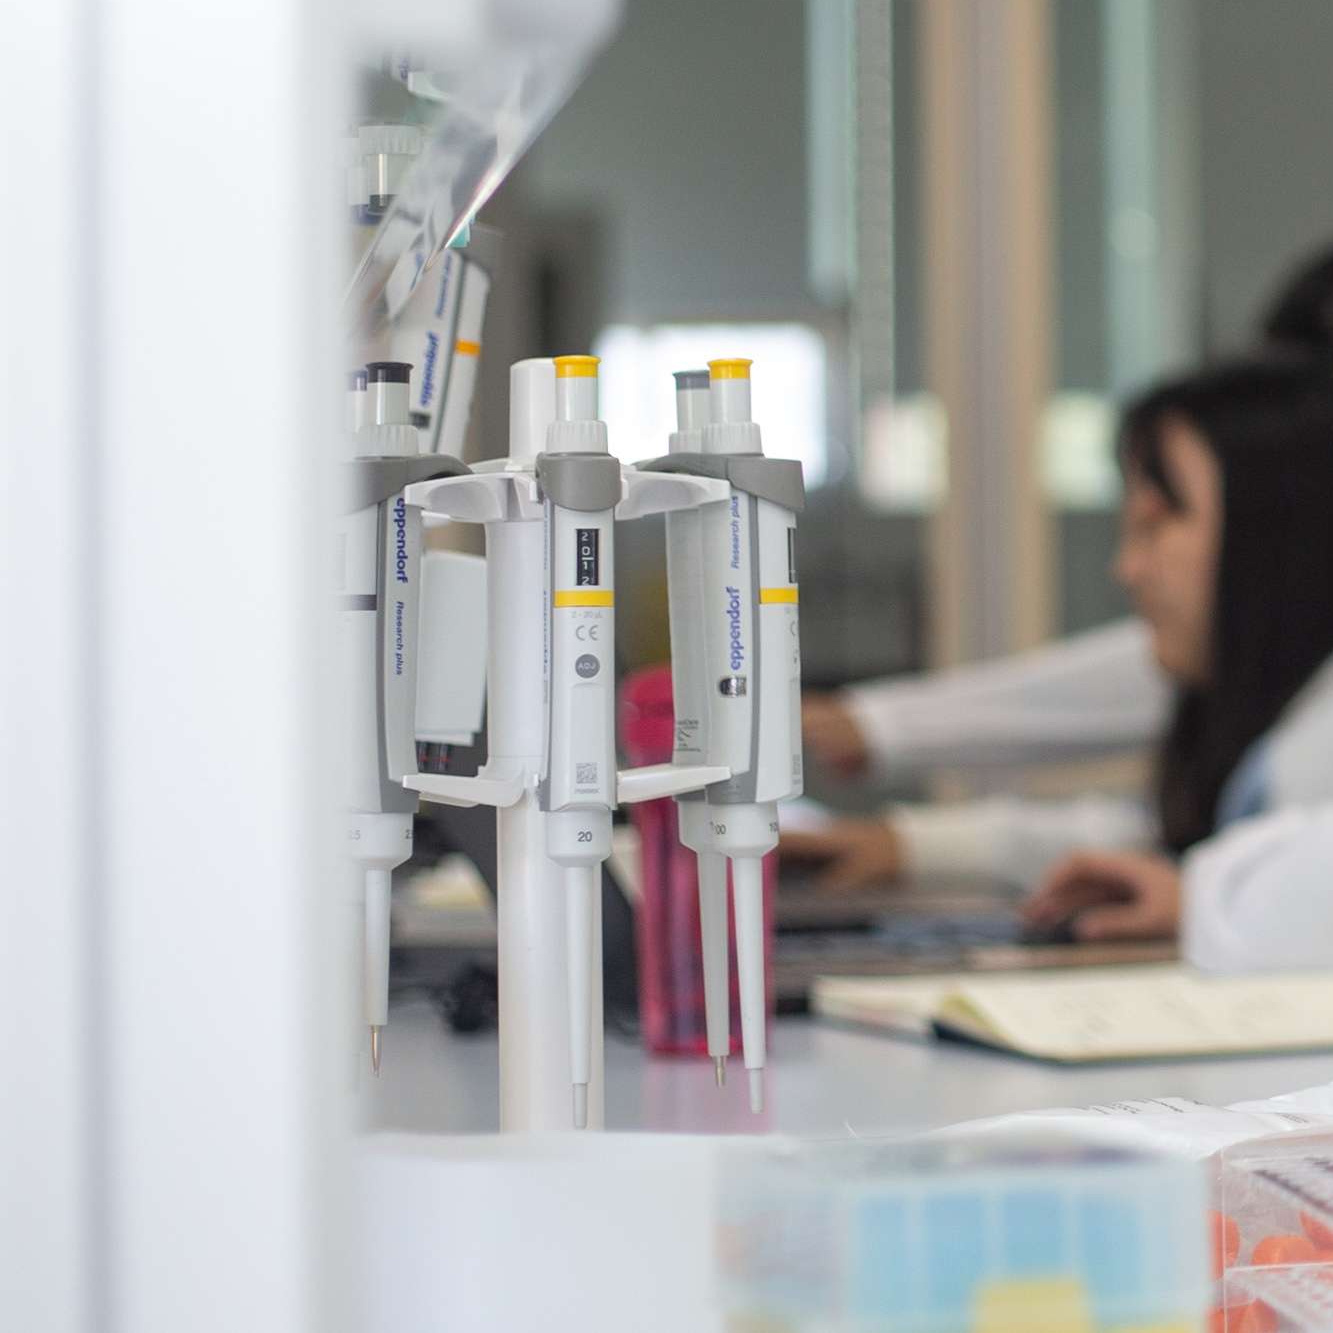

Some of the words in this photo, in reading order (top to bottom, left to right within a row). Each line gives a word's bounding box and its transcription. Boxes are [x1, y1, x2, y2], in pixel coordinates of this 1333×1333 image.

[731, 495, 741, 518] plus
[393, 497, 408, 583] eppendorf
[730, 520, 740, 569] Research
[395, 601, 404, 651] Research
[726, 586, 744, 670] eppendorf
[395, 652, 404, 676] plus
[577, 831, 593, 843] 20
